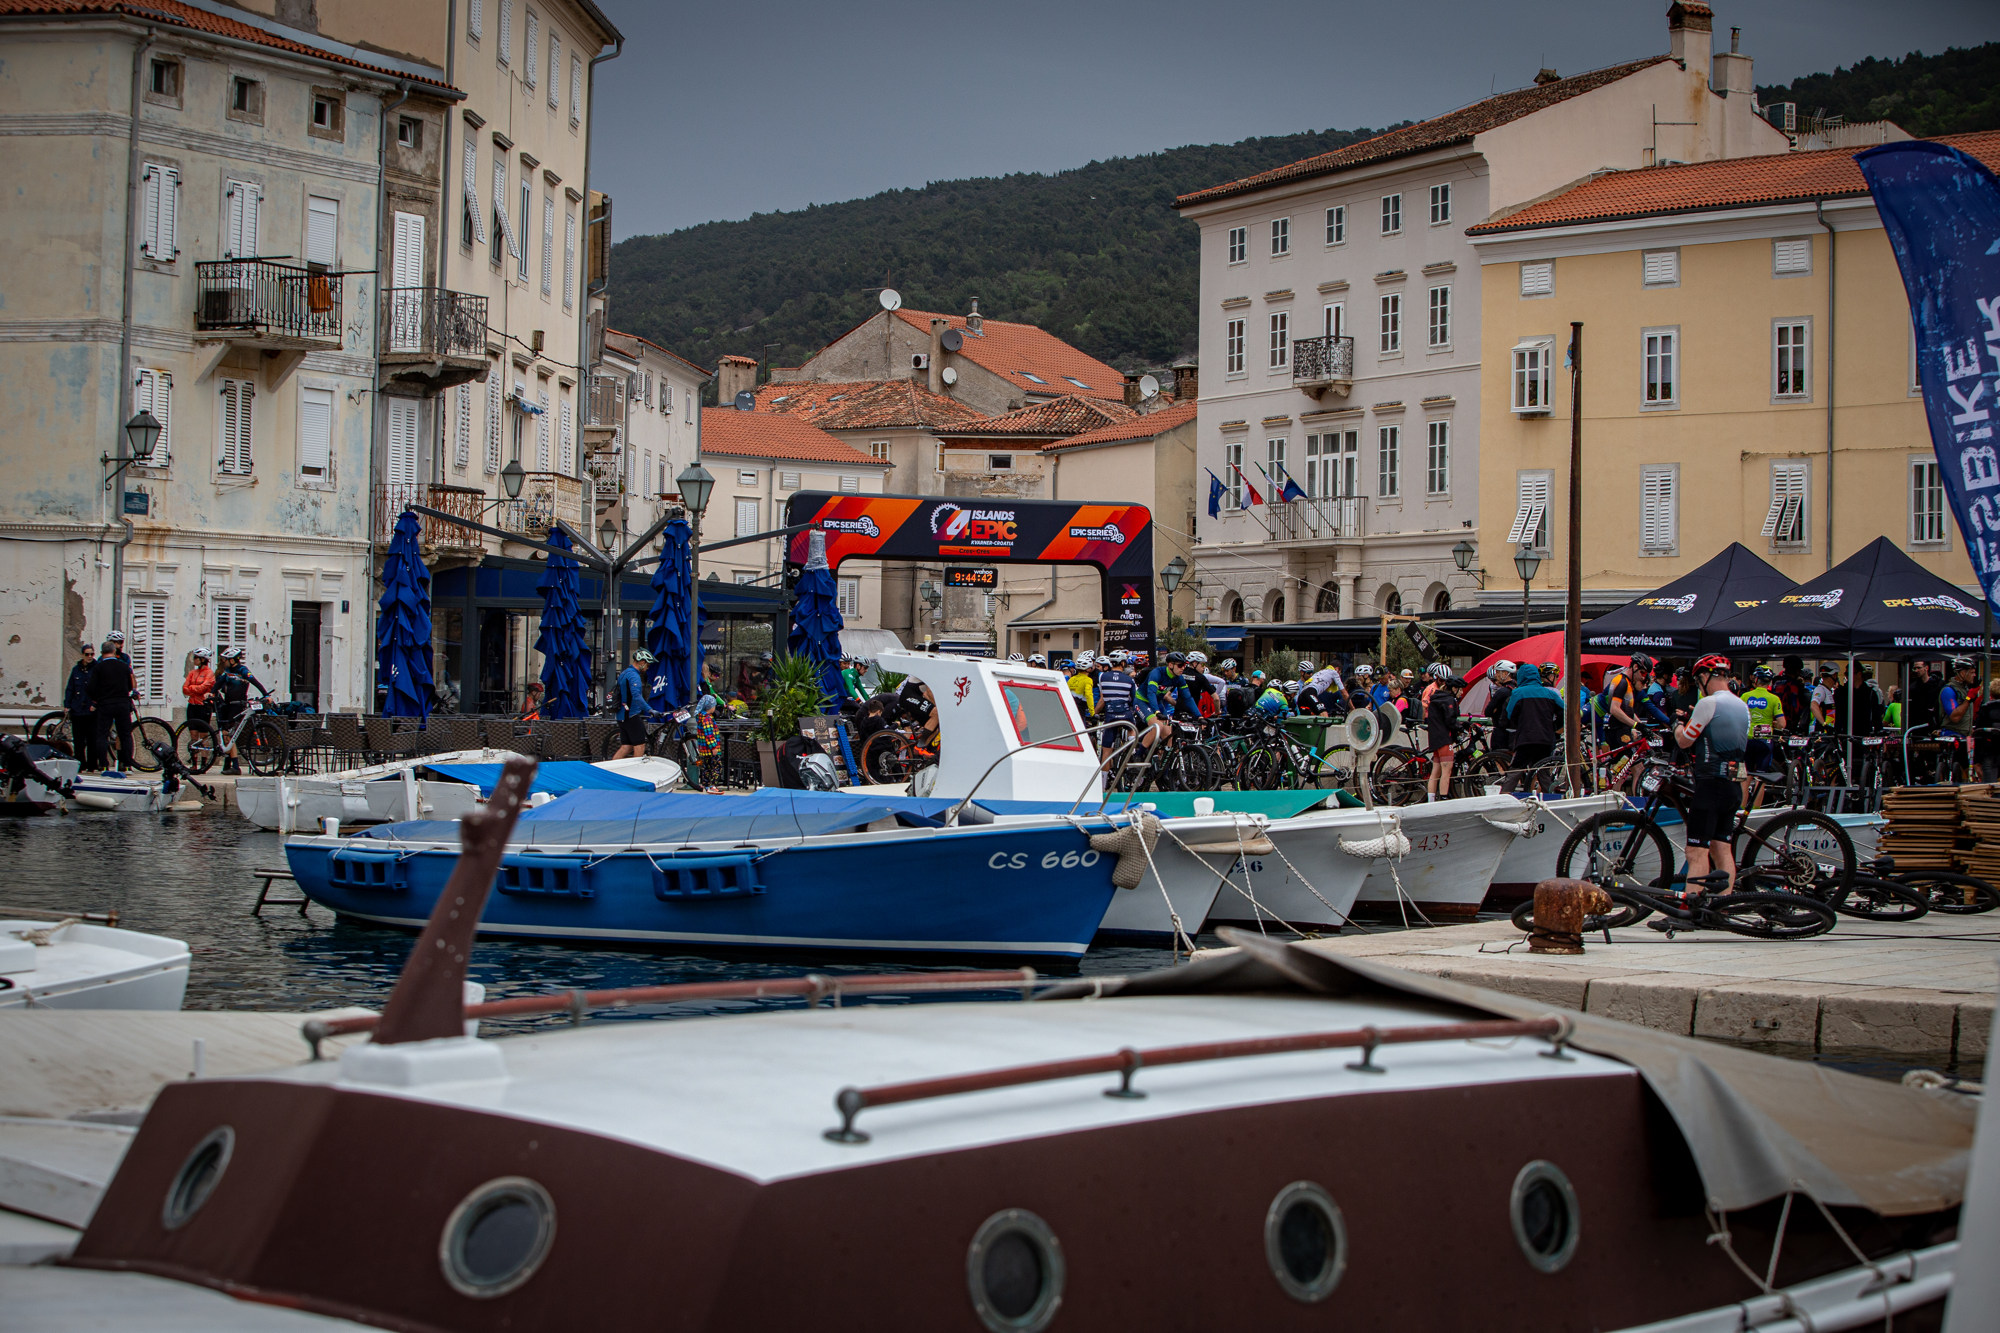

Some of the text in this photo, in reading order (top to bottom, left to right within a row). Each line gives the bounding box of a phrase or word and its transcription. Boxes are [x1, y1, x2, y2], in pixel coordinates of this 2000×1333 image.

[971, 510, 1015, 521] ISLANDS
[823, 520, 867, 529] EPIC SERIES
[971, 520, 1018, 540] EPIC
[1071, 528, 1114, 537] EPIC SERIES
[954, 572, 993, 583] 9:44:42
[1637, 597, 1687, 606] EPIC SERIES
[1734, 600, 1760, 608] EPIC
[1779, 595, 1834, 603] EPIC SERIES
[1882, 597, 1957, 609] EPIC SERIES
[1588, 634, 1673, 647] www.epic-series.com
[1729, 632, 1821, 648] www.epic-series.com
[1748, 699, 1767, 707] KMC
[1417, 833, 1450, 851] 433
[1791, 839, 1838, 851] CS 107
[988, 848, 1101, 869] CS 660
